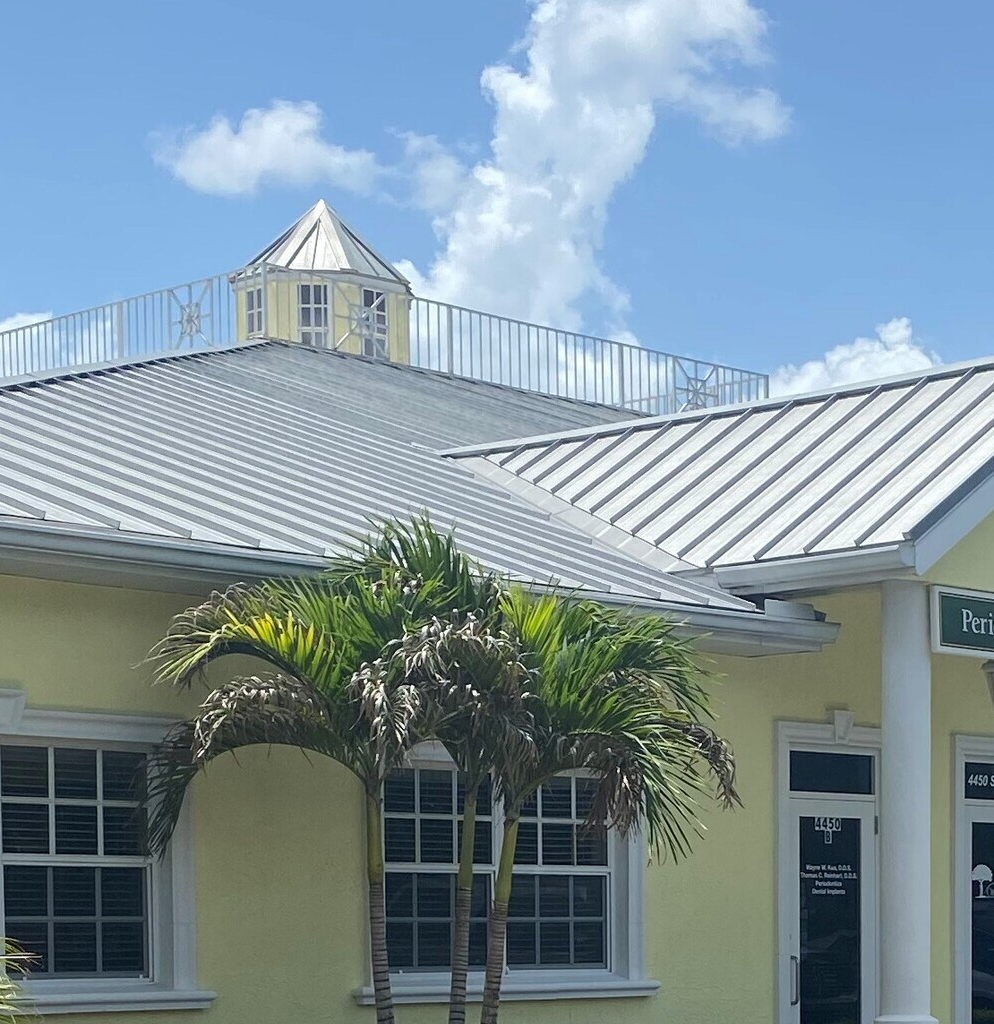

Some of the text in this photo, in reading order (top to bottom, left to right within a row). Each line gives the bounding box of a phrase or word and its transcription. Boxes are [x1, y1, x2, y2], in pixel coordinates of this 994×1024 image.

[967, 774, 988, 786] 4450
[815, 818, 841, 830] 4450
[825, 831, 831, 842] B
